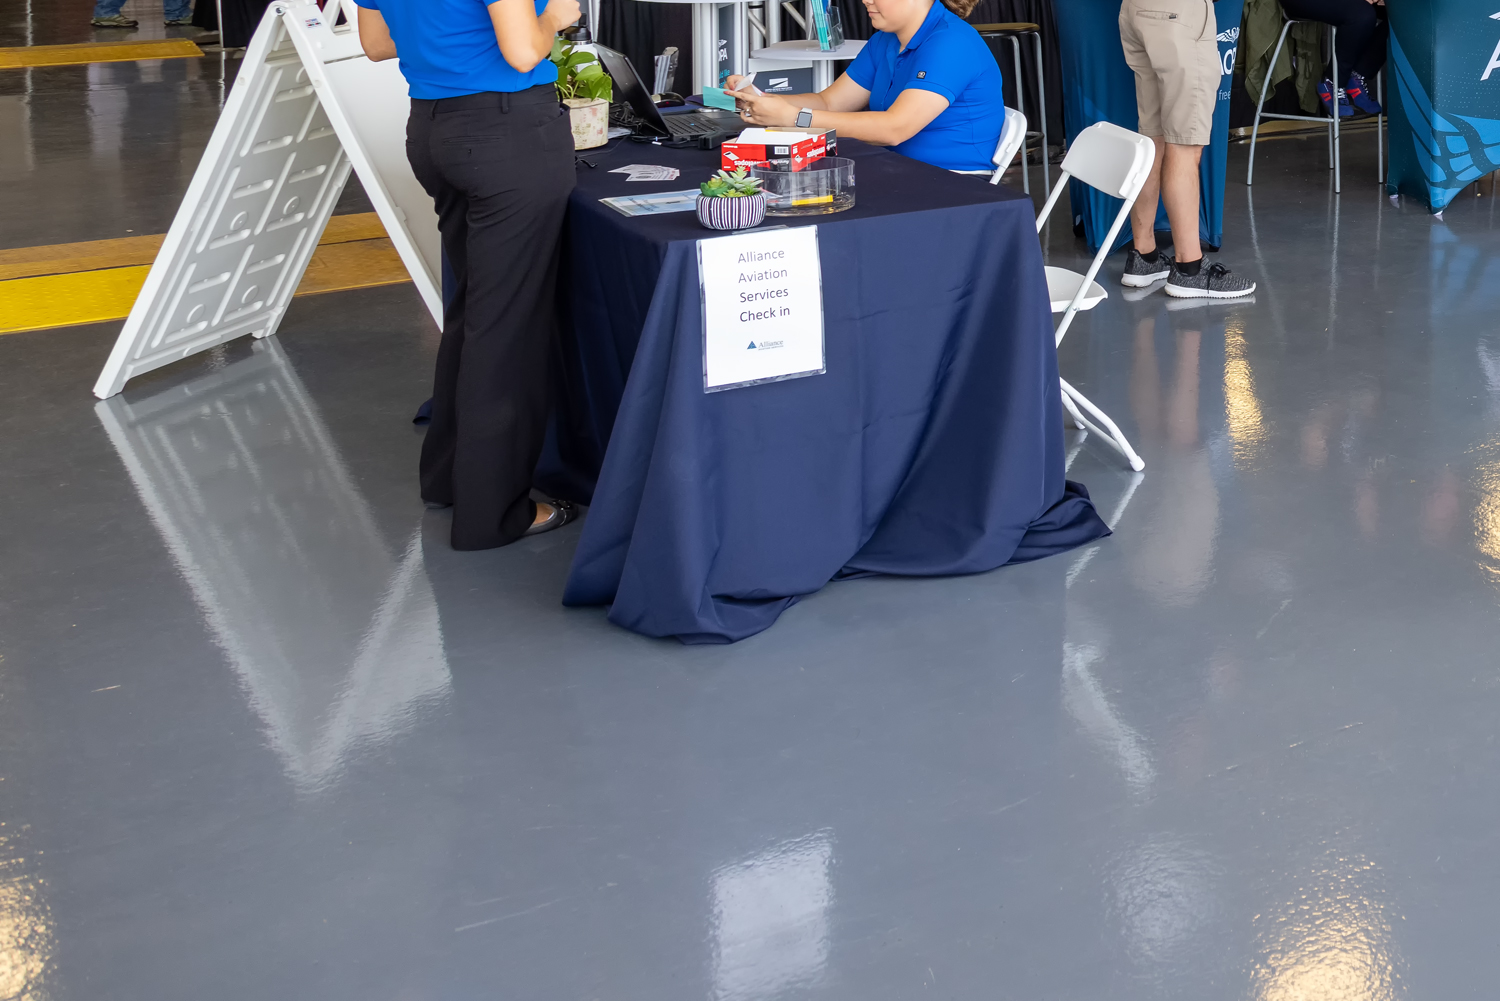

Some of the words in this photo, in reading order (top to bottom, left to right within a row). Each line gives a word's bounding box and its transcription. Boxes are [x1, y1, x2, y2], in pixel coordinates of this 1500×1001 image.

[1218, 90, 1231, 101] free
[738, 250, 785, 264] Alliance
[738, 268, 788, 284] Aviation
[740, 288, 789, 303] Services
[740, 307, 776, 322] Check
[779, 306, 790, 317] in
[758, 340, 784, 349] Alliance
